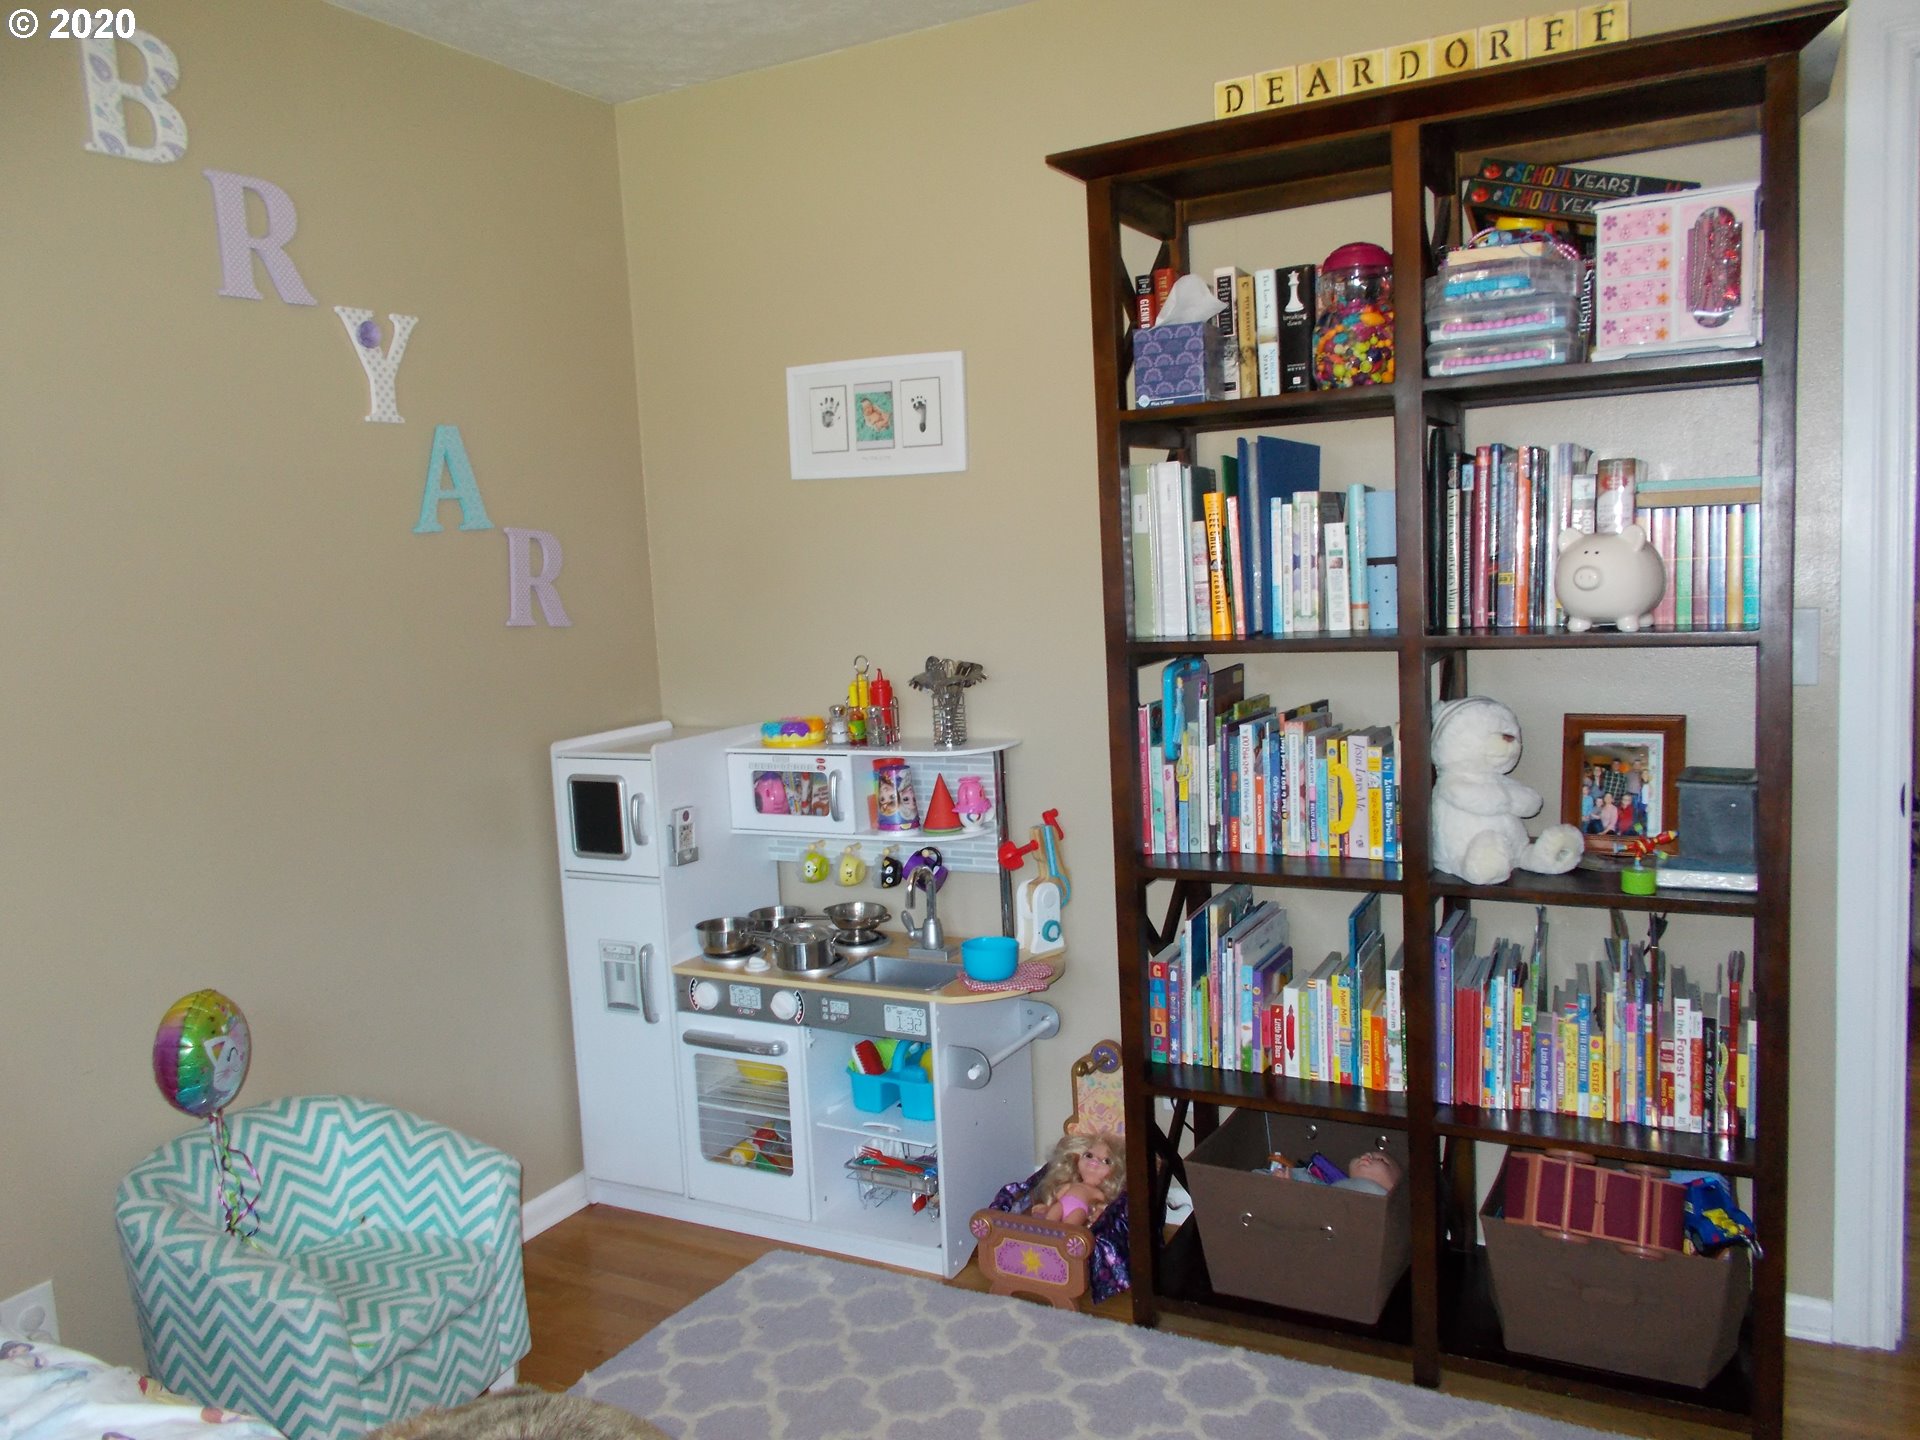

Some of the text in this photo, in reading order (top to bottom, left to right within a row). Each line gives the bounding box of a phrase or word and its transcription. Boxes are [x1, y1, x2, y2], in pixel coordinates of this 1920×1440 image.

[1224, 9, 1615, 114] DEARDORFF
[1513, 163, 1641, 196] SCHOOL YEARS!
[1500, 187, 1598, 216] SCHOOL YEA
[1159, 276, 1168, 289] THE
[1140, 299, 1150, 322] GLENN
[1269, 349, 1277, 384] NICHOLAS
[1208, 512, 1222, 556] LEE CHILD
[1448, 493, 1459, 610] AND THE CROWD GOES WILD
[1213, 575, 1224, 615] PERSONAL
[1353, 743, 1365, 766] Jesus
[1355, 768, 1366, 791] Loves
[1385, 778, 1393, 843] Little Blue Truck
[1274, 1018, 1282, 1058] Little Red Barn
[1676, 1005, 1688, 1078] In the Forest
[1540, 1047, 1549, 1065] Little
[1540, 1065, 1549, 1079] Blue
[1592, 1062, 1600, 1094] EASTER
[1661, 1098, 1668, 1107] On
